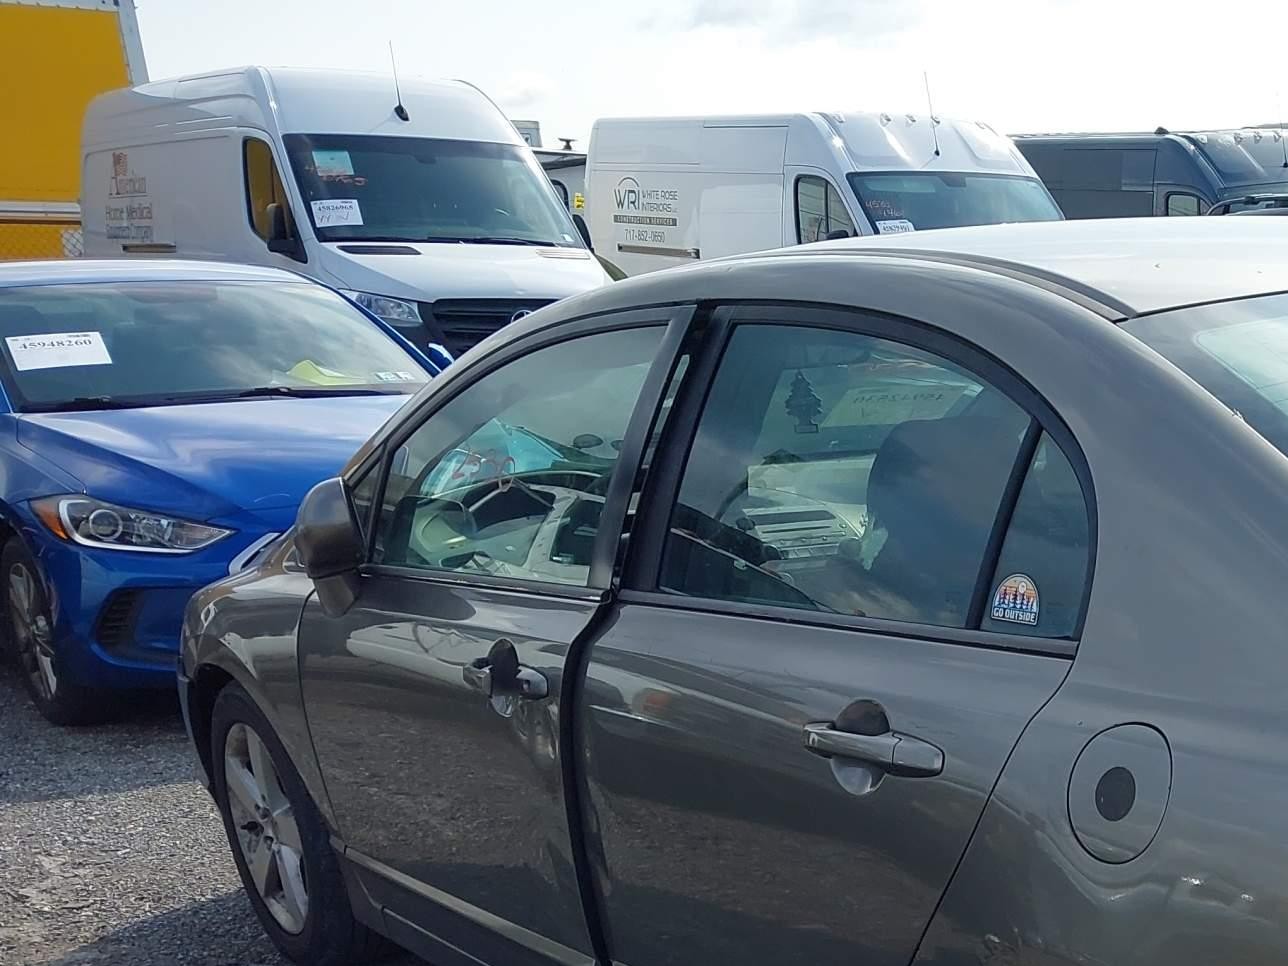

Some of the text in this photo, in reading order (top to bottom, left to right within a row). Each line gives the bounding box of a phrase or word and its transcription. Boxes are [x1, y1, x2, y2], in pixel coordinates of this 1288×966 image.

[614, 189, 640, 210] WRI
[641, 190, 678, 201] WHITE ROSE
[19, 339, 92, 349] 45948260
[993, 607, 1036, 622] GO OUTSIDE
